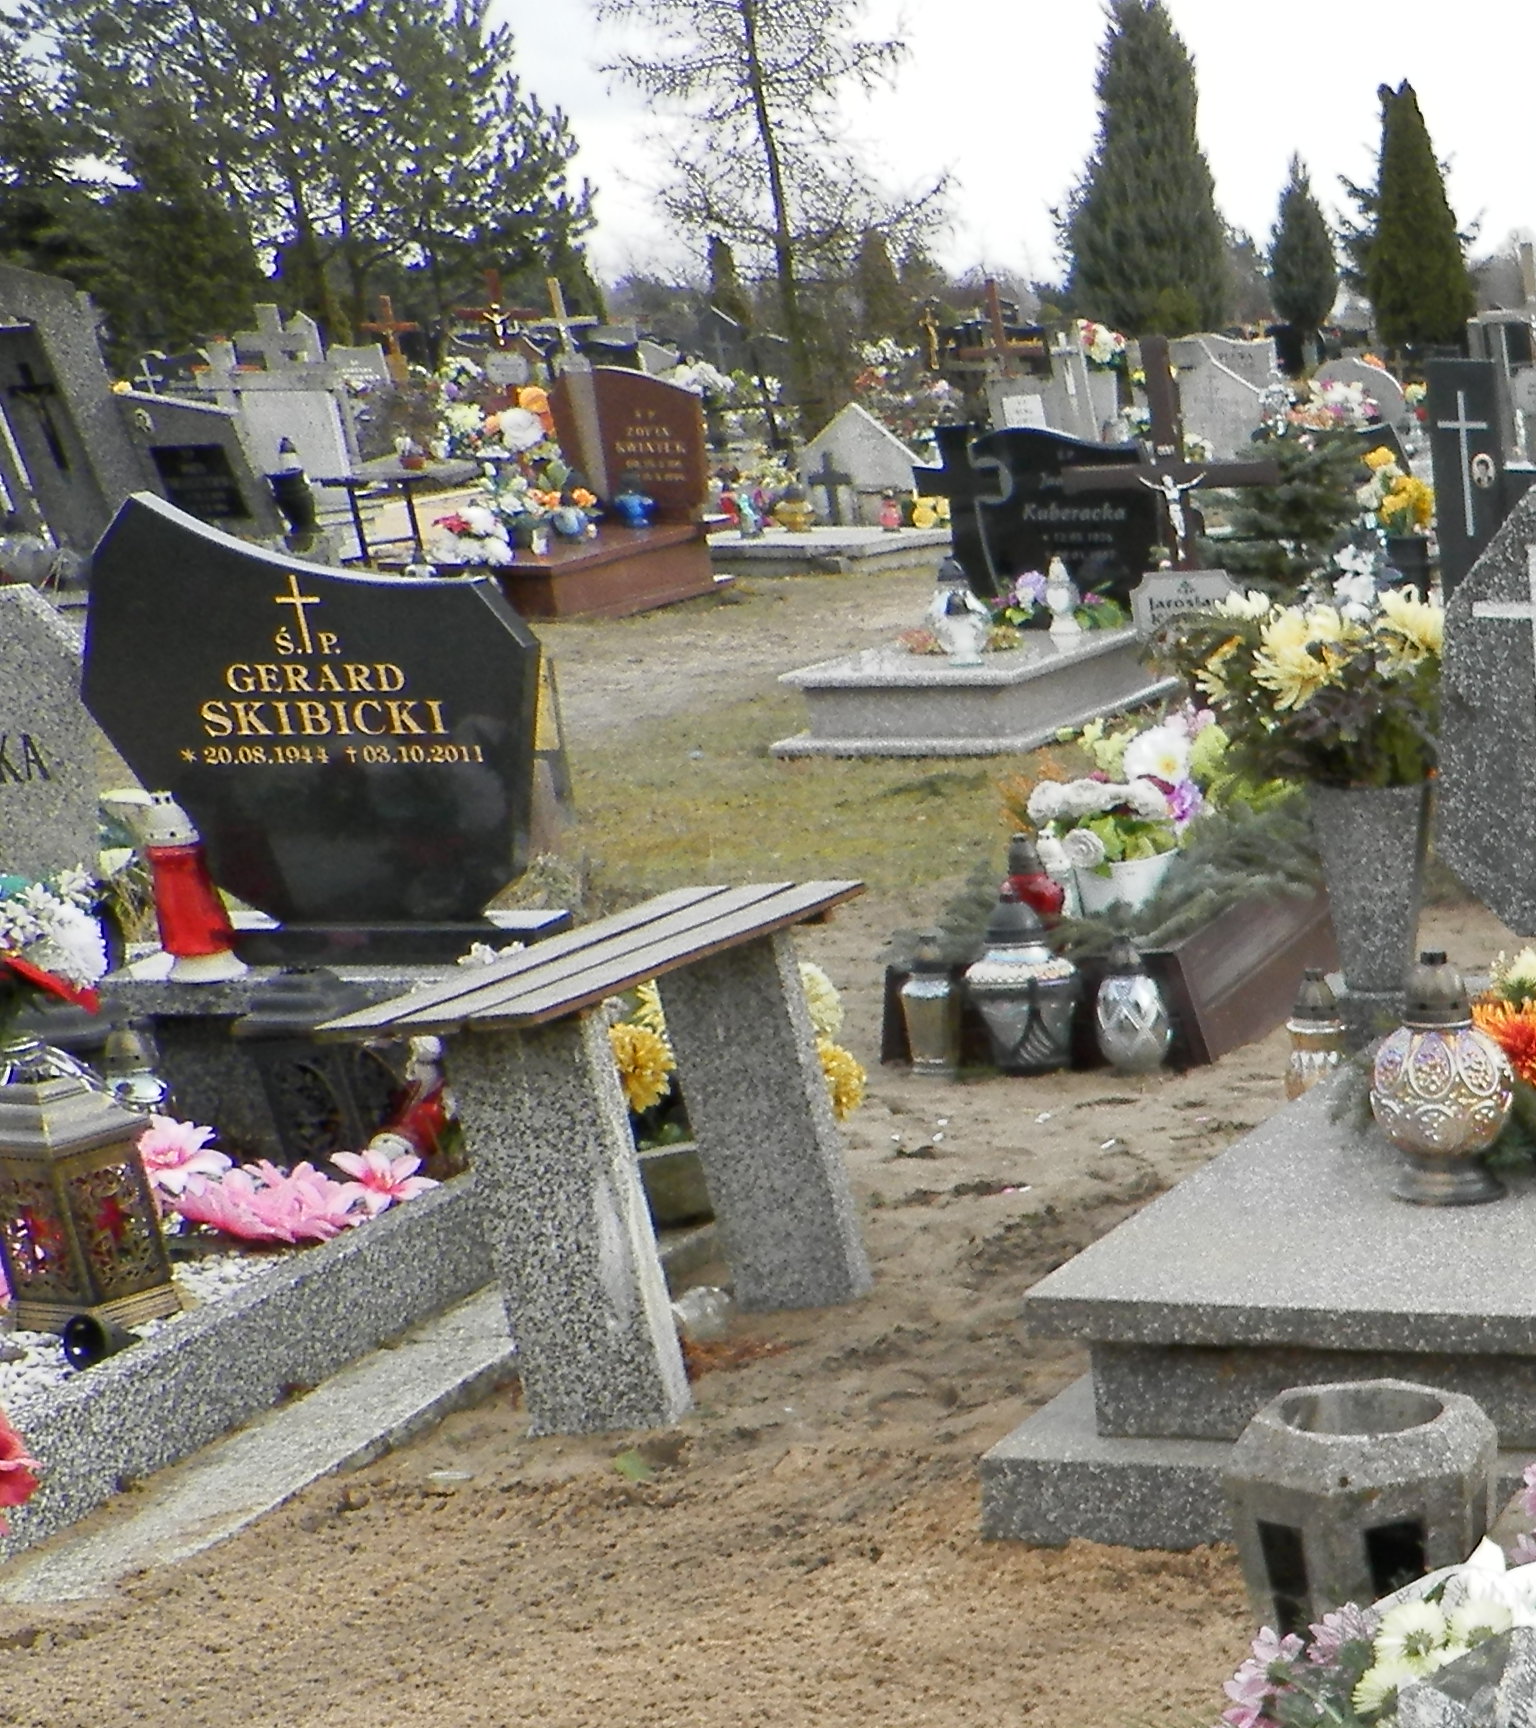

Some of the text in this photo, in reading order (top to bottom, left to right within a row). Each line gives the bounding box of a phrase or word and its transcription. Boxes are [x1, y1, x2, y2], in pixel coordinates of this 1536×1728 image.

[318, 632, 342, 655] P.
[225, 663, 406, 693] GERARD
[200, 699, 450, 737] SKIBICKI
[203, 744, 485, 765] 20.08.1944 03.10.2011
